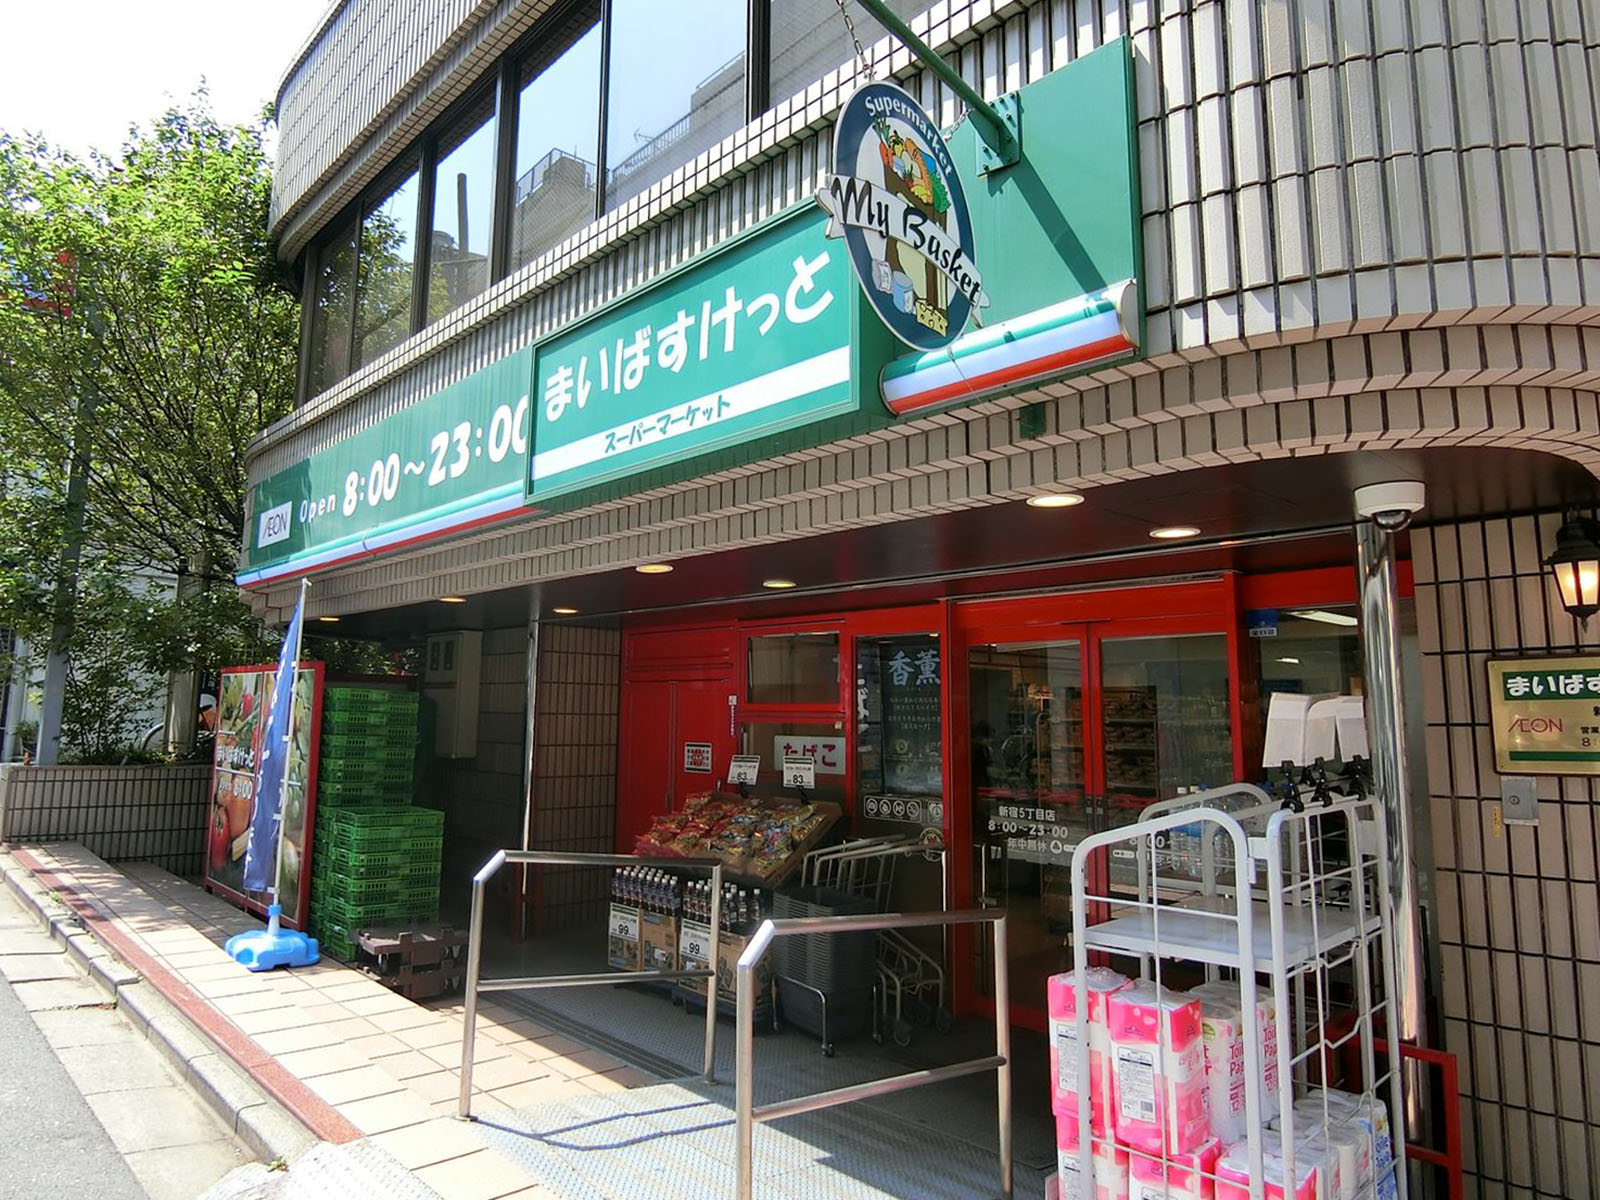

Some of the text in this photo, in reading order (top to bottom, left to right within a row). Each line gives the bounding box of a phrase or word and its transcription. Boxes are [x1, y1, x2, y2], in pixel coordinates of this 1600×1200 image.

[864, 94, 954, 177] Supermarket
[831, 176, 981, 304] My Basket
[544, 251, 834, 422] まいばすけっと
[604, 395, 731, 453] スーパーマーケット
[299, 493, 337, 523] Open
[888, 650, 941, 686] 香薫
[736, 771, 748, 781] 83
[792, 774, 804, 784] 83
[998, 805, 1056, 822] 新宿5丁目店
[618, 924, 630, 936] 99
[688, 942, 701, 955] 99
